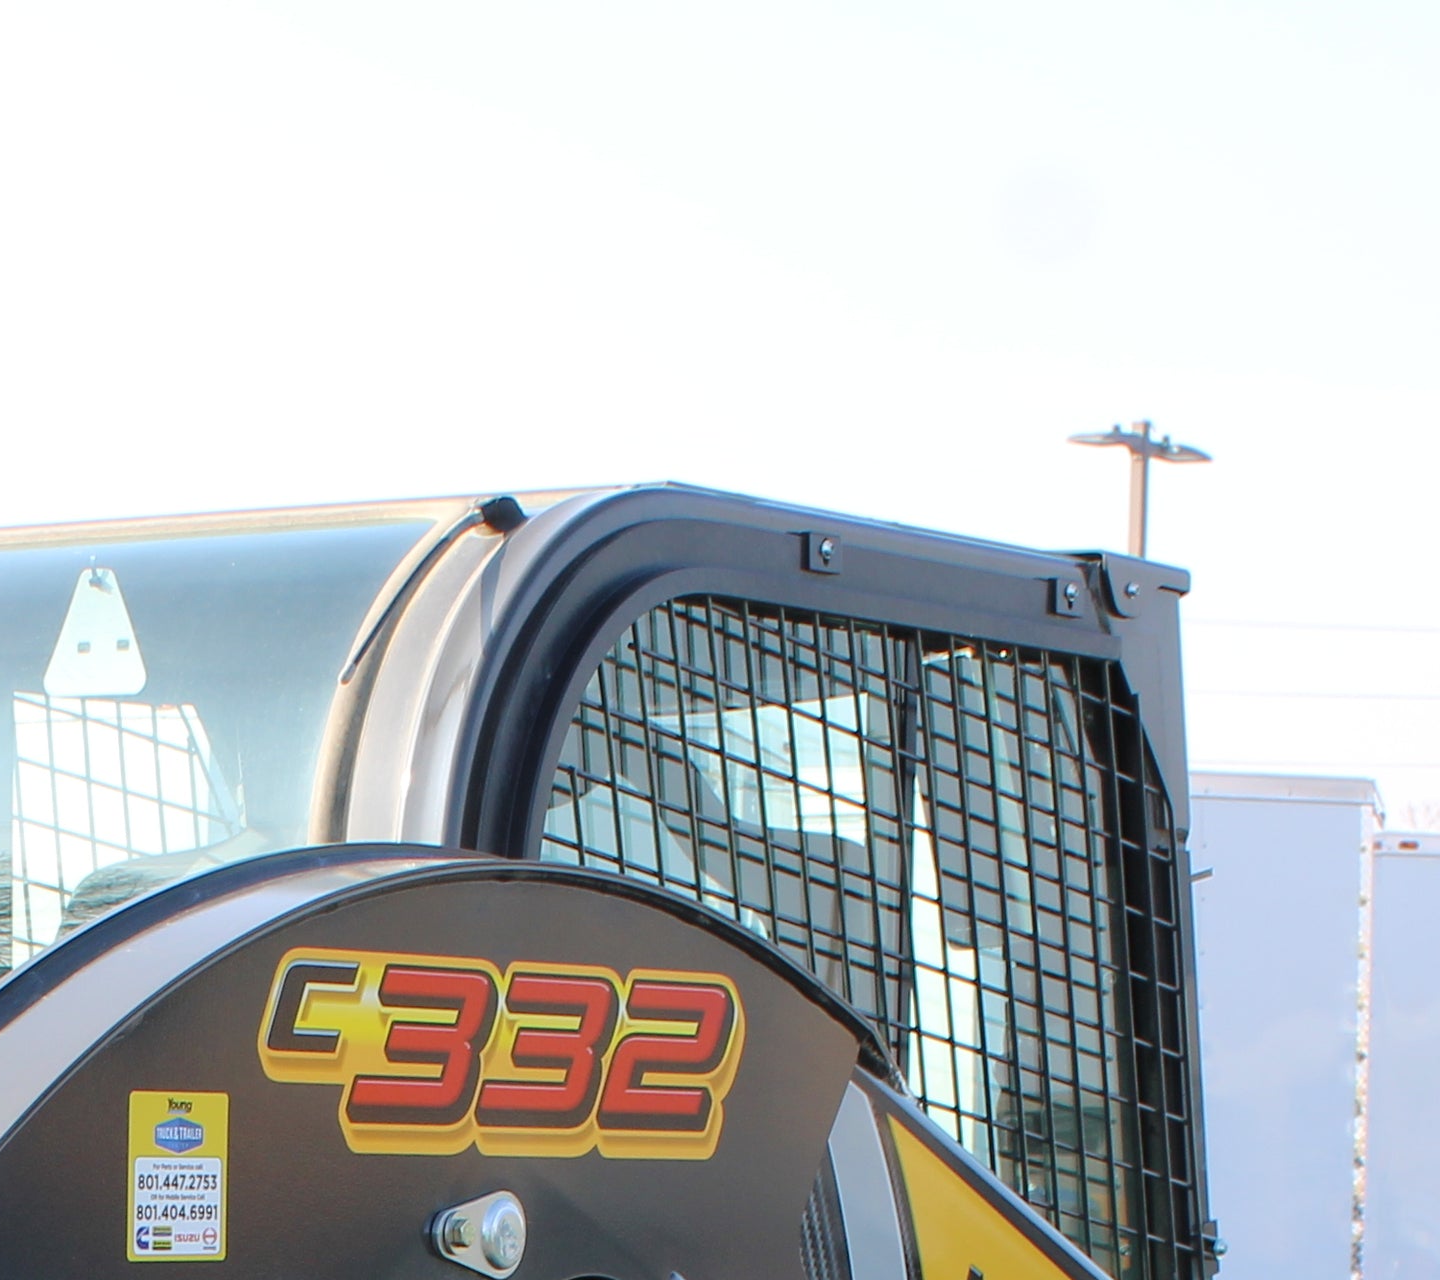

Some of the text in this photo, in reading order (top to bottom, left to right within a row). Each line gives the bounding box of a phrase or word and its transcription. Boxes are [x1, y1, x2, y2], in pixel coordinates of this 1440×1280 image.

[262, 952, 740, 1150] C332
[167, 1097, 193, 1113] Young
[138, 1174, 217, 1190] 801.447.2753
[136, 1204, 218, 1220] 801.404.6991
[174, 1233, 200, 1242] ISUZU
